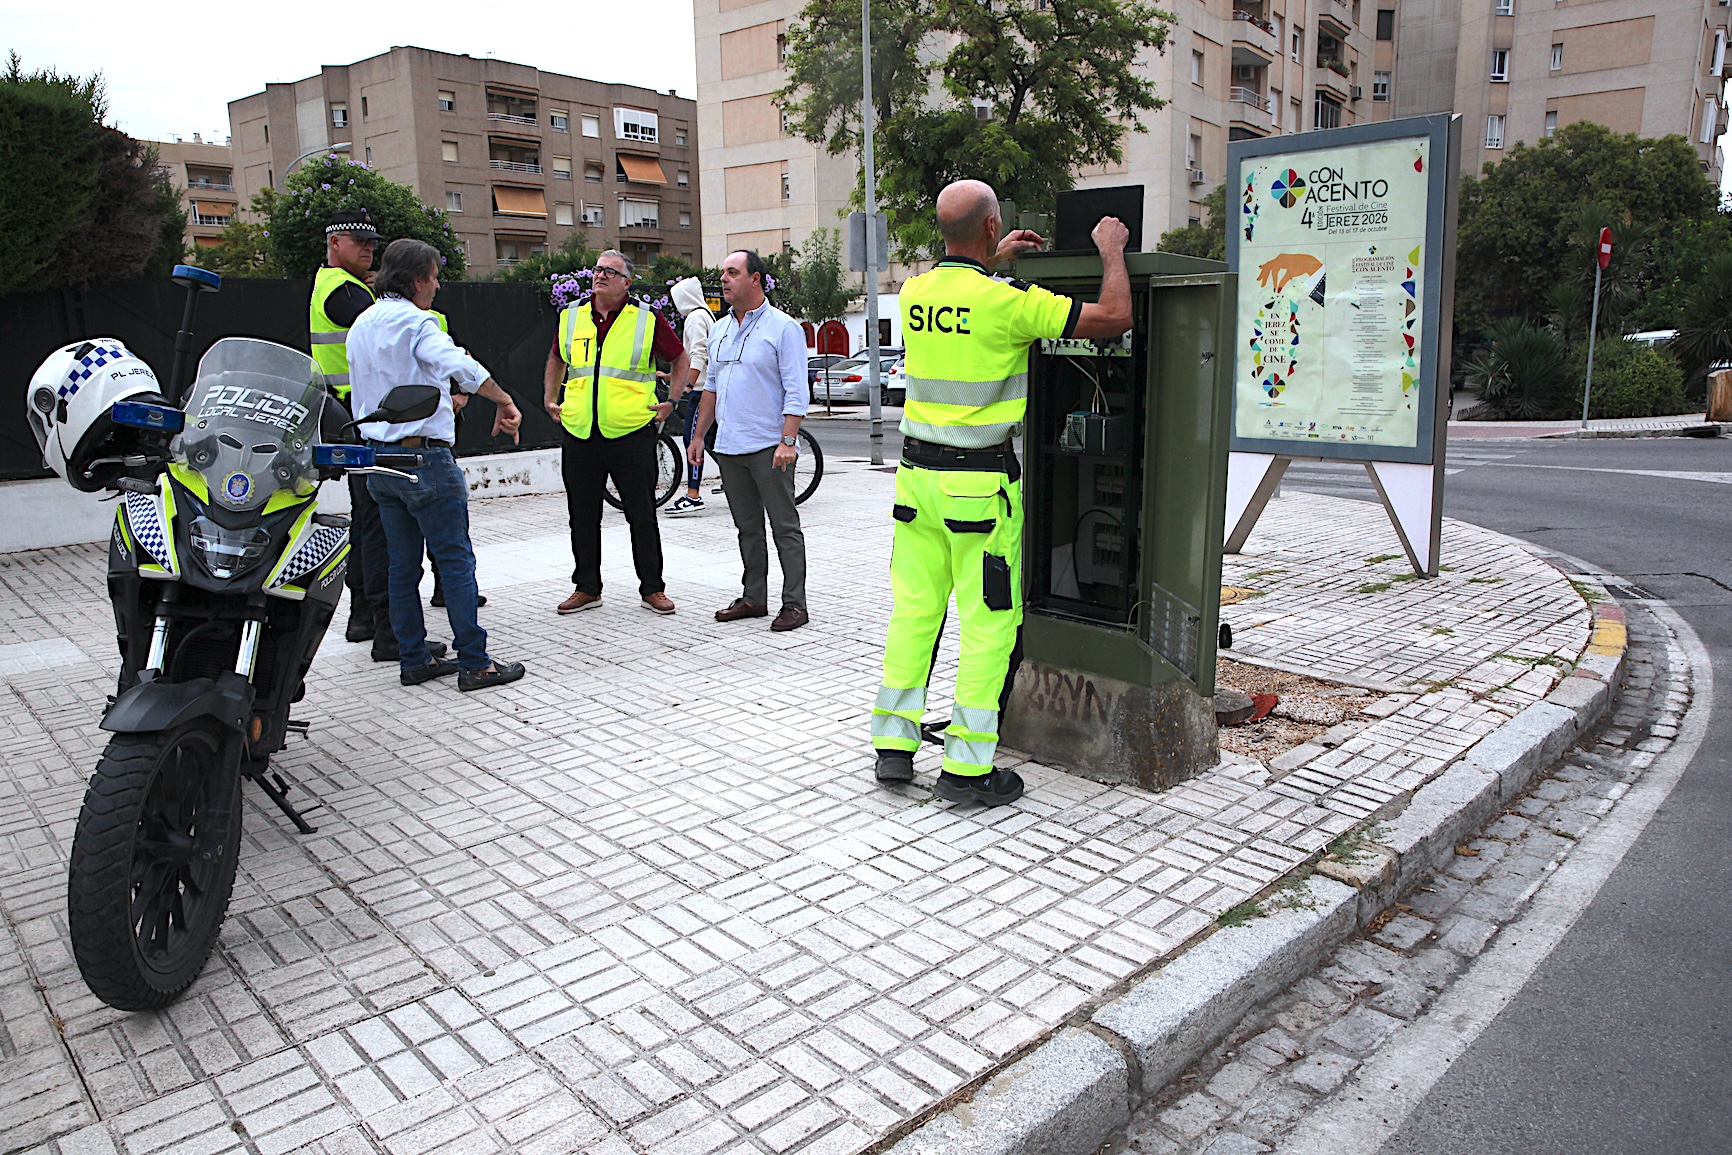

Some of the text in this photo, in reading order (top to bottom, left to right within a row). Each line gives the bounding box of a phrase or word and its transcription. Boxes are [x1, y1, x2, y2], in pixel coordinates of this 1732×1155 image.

[1309, 167, 1343, 183] CON
[1305, 179, 1388, 204] ACENTO
[1326, 203, 1356, 212] Festival
[1371, 201, 1388, 210] Cine
[1317, 212, 1388, 230] JEREZ 2026
[1367, 225, 1388, 233] octubre
[908, 304, 971, 335] SICE
[1265, 321, 1286, 329] JEREZ
[1263, 355, 1286, 364] CINE
[110, 368, 155, 381] PL JEREZ
[197, 406, 298, 434] LOCAL JEREZ
